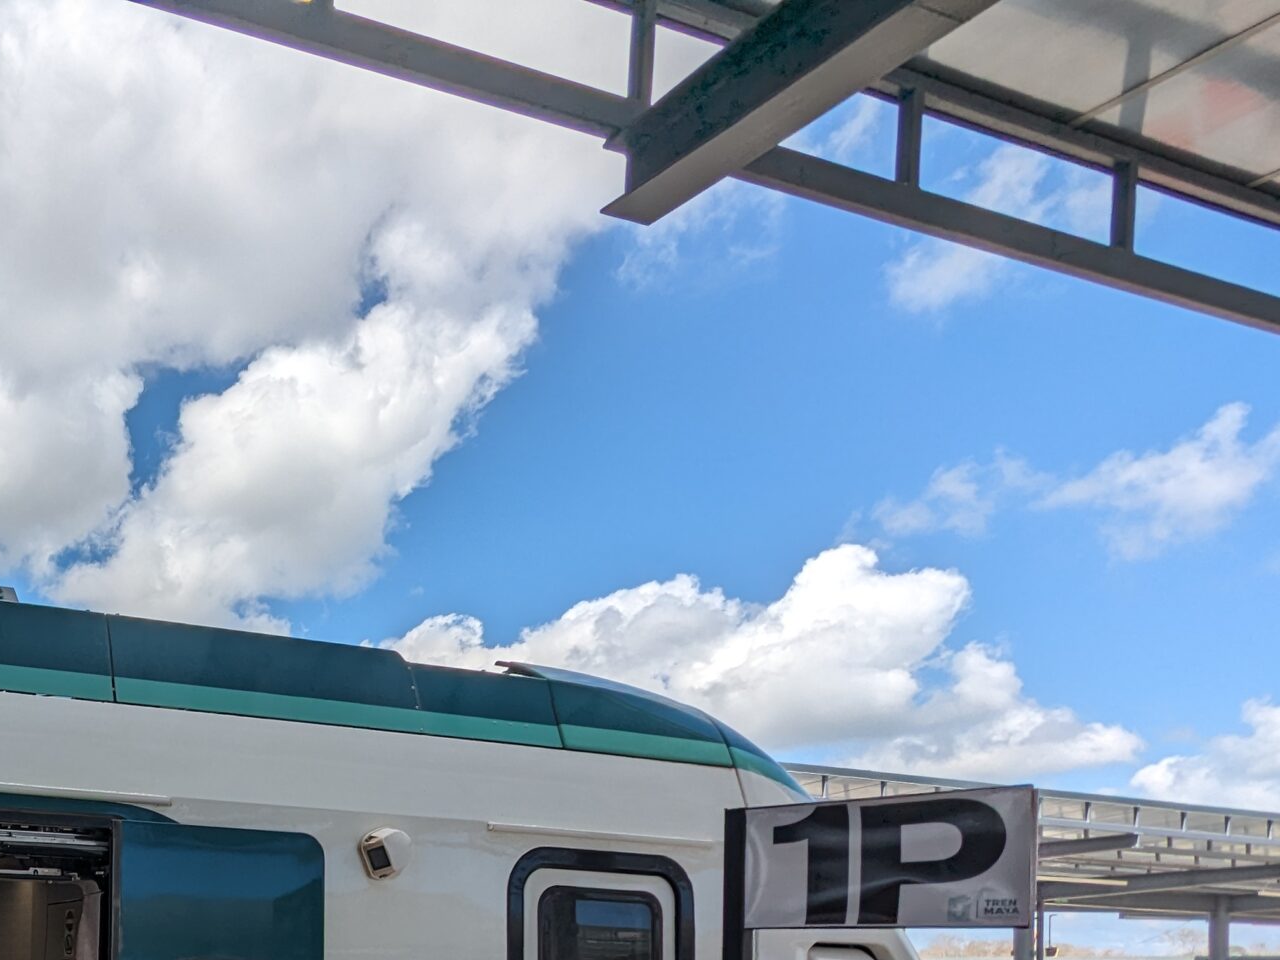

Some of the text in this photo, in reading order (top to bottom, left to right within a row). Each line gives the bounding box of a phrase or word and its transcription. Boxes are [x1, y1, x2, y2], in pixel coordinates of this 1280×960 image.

[773, 798, 1007, 924] 1P
[984, 899, 1017, 907] TREN
[984, 907, 1019, 915] MAYA
